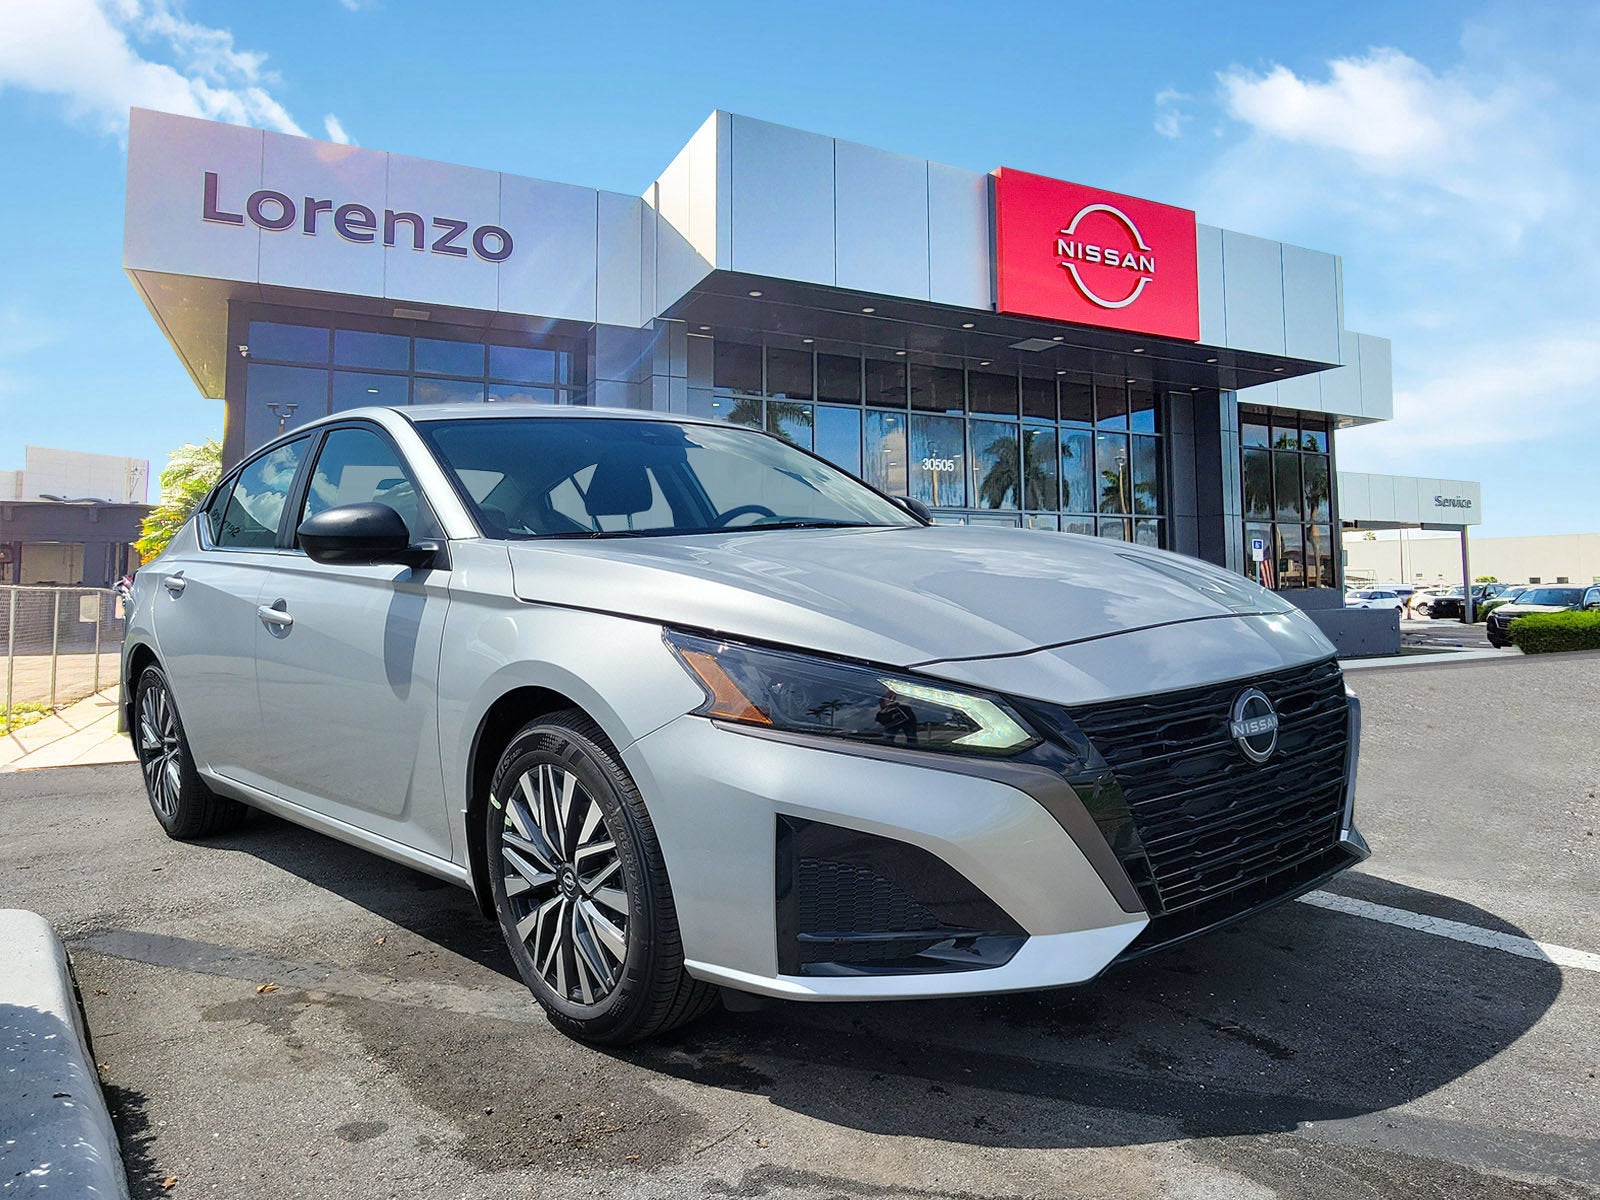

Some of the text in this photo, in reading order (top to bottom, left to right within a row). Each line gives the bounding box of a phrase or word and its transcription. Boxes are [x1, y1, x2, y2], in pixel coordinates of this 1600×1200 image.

[203, 171, 514, 262] Lorenzo
[1057, 238, 1155, 273] NISSAN
[922, 458, 955, 471] 30505
[1434, 495, 1472, 508] Service
[1233, 716, 1279, 736] NISSAN
